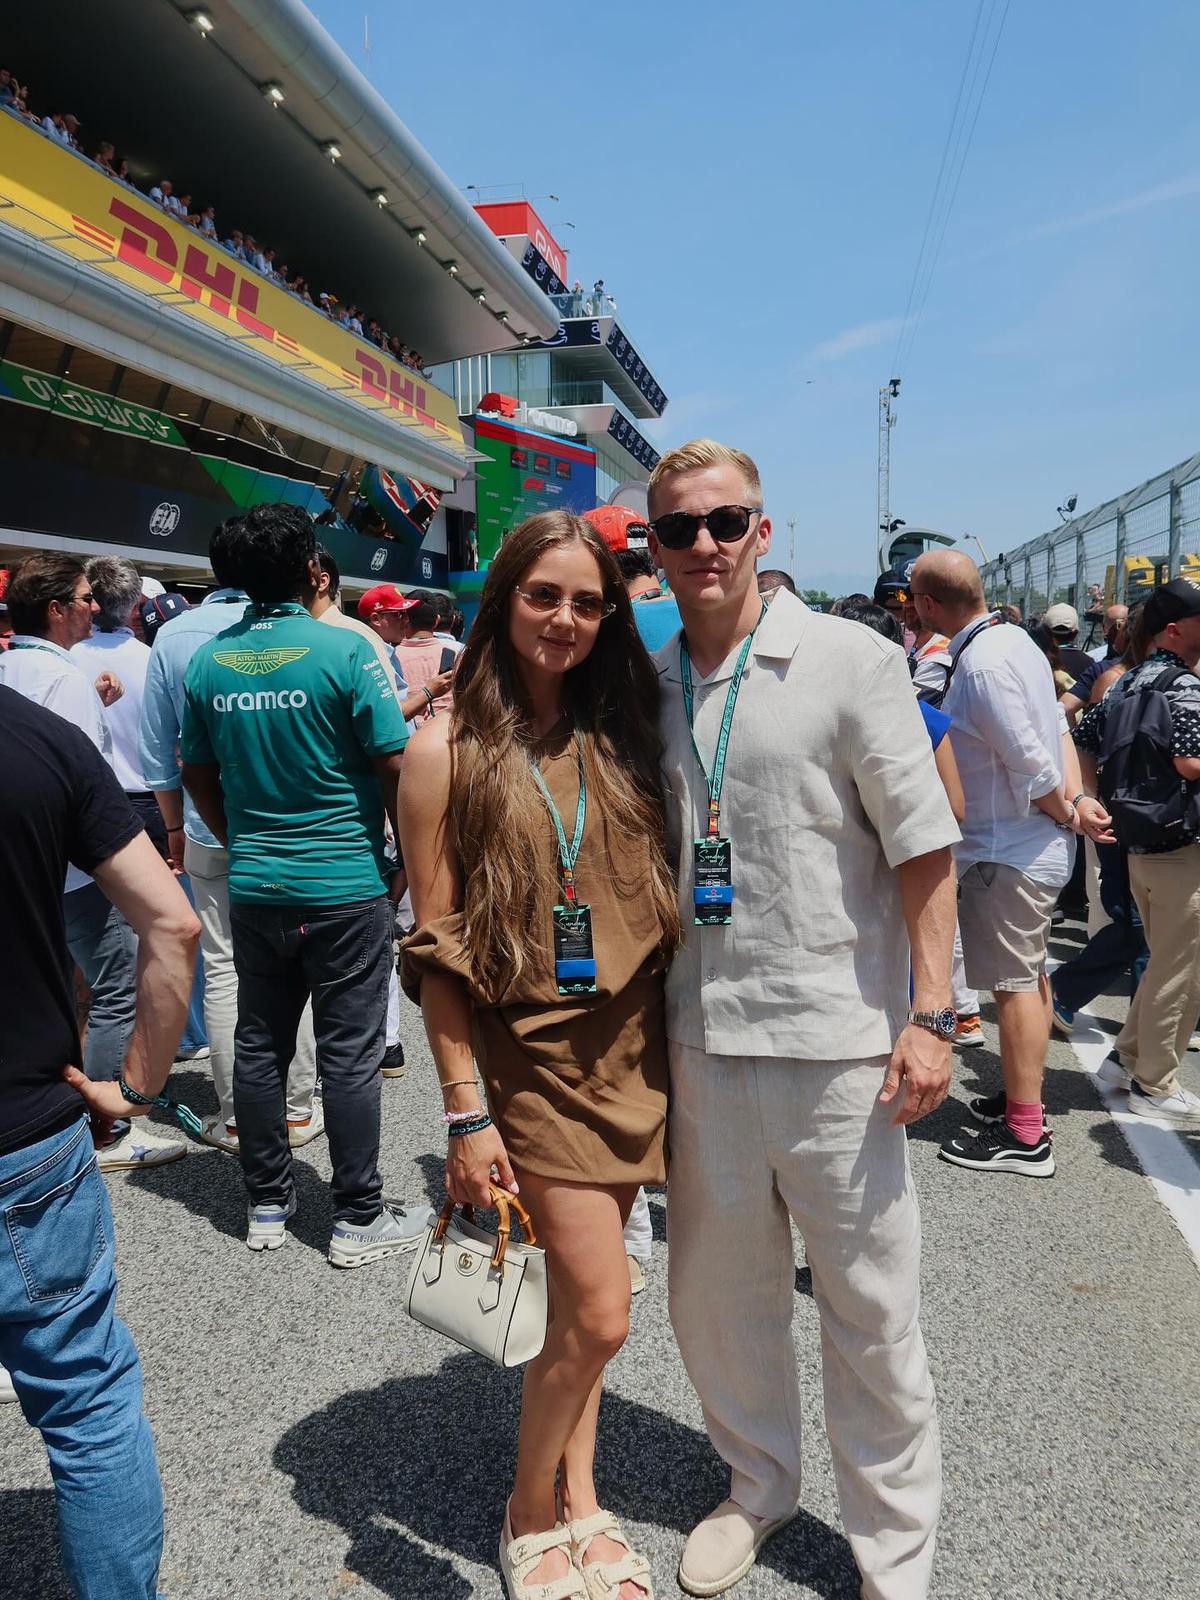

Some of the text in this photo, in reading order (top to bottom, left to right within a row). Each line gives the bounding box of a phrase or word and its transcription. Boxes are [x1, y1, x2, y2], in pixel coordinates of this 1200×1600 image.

[109, 197, 274, 342] DHL
[355, 348, 436, 429] DHL
[166, 599, 176, 609] 1
[250, 622, 273, 631] BOSS
[213, 689, 307, 712] aramco
[698, 848, 726, 867] Sunday
[559, 914, 587, 934] Sunday
[344, 1232, 360, 1241] ON
